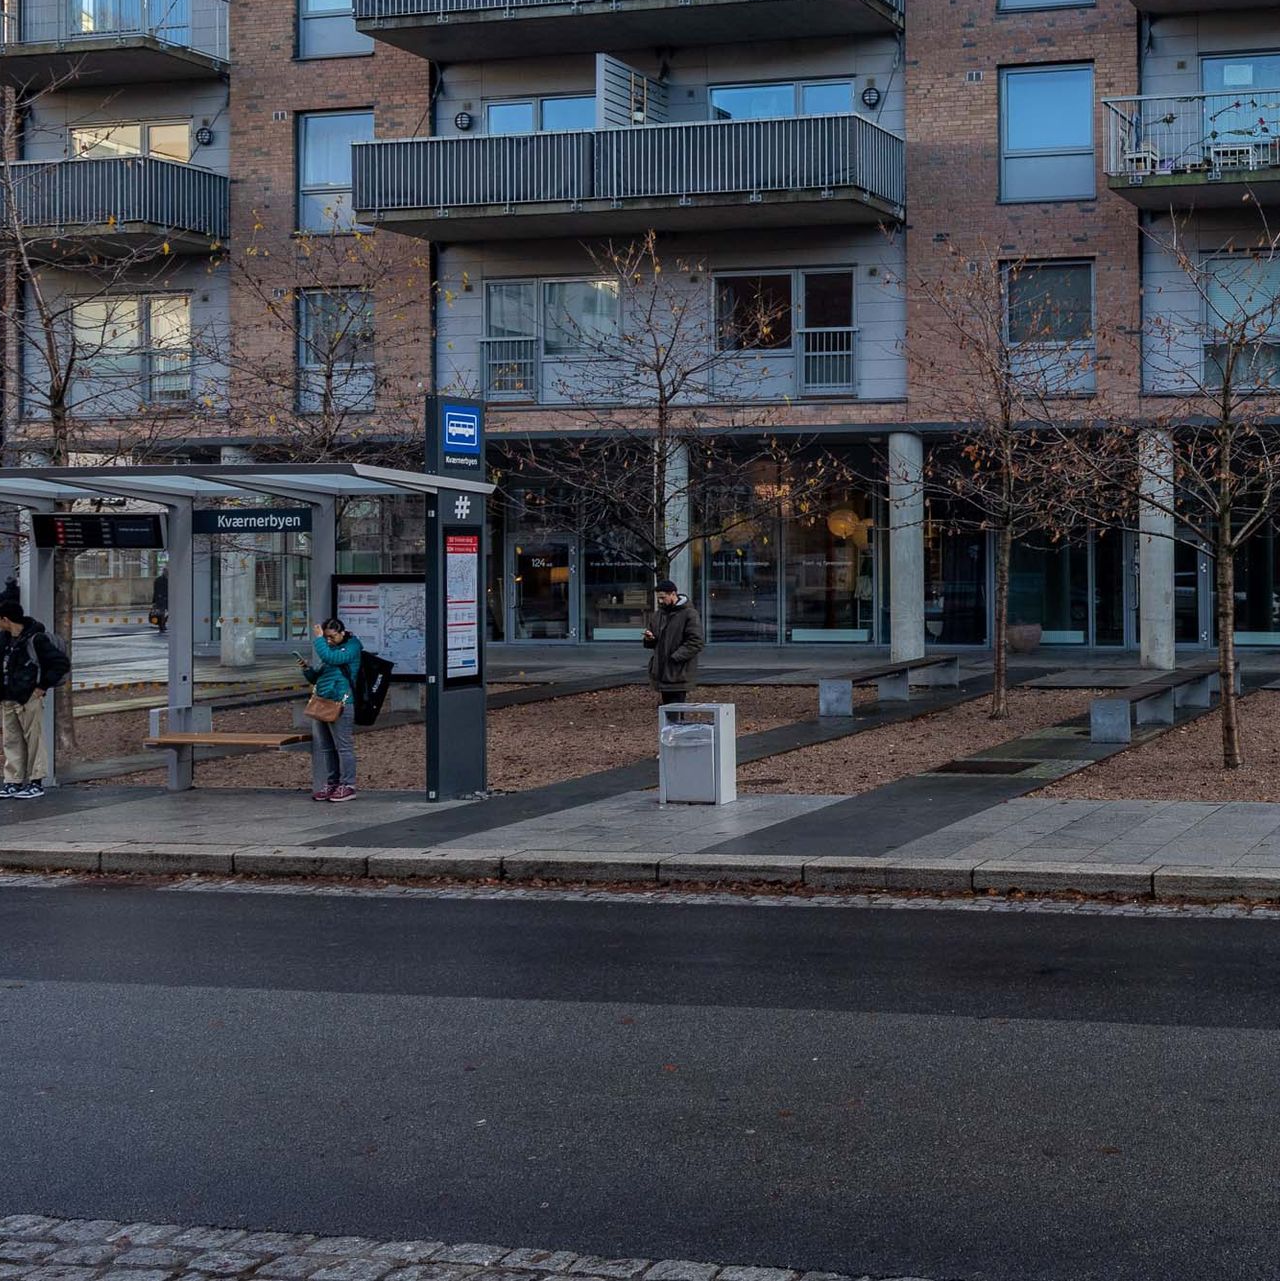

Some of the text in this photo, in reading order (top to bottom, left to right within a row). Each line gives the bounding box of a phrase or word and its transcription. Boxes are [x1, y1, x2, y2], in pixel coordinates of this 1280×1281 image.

[445, 456, 478, 466] Kværnerbyen
[217, 514, 301, 530] Kværnerbyen
[531, 558, 545, 568] 124
